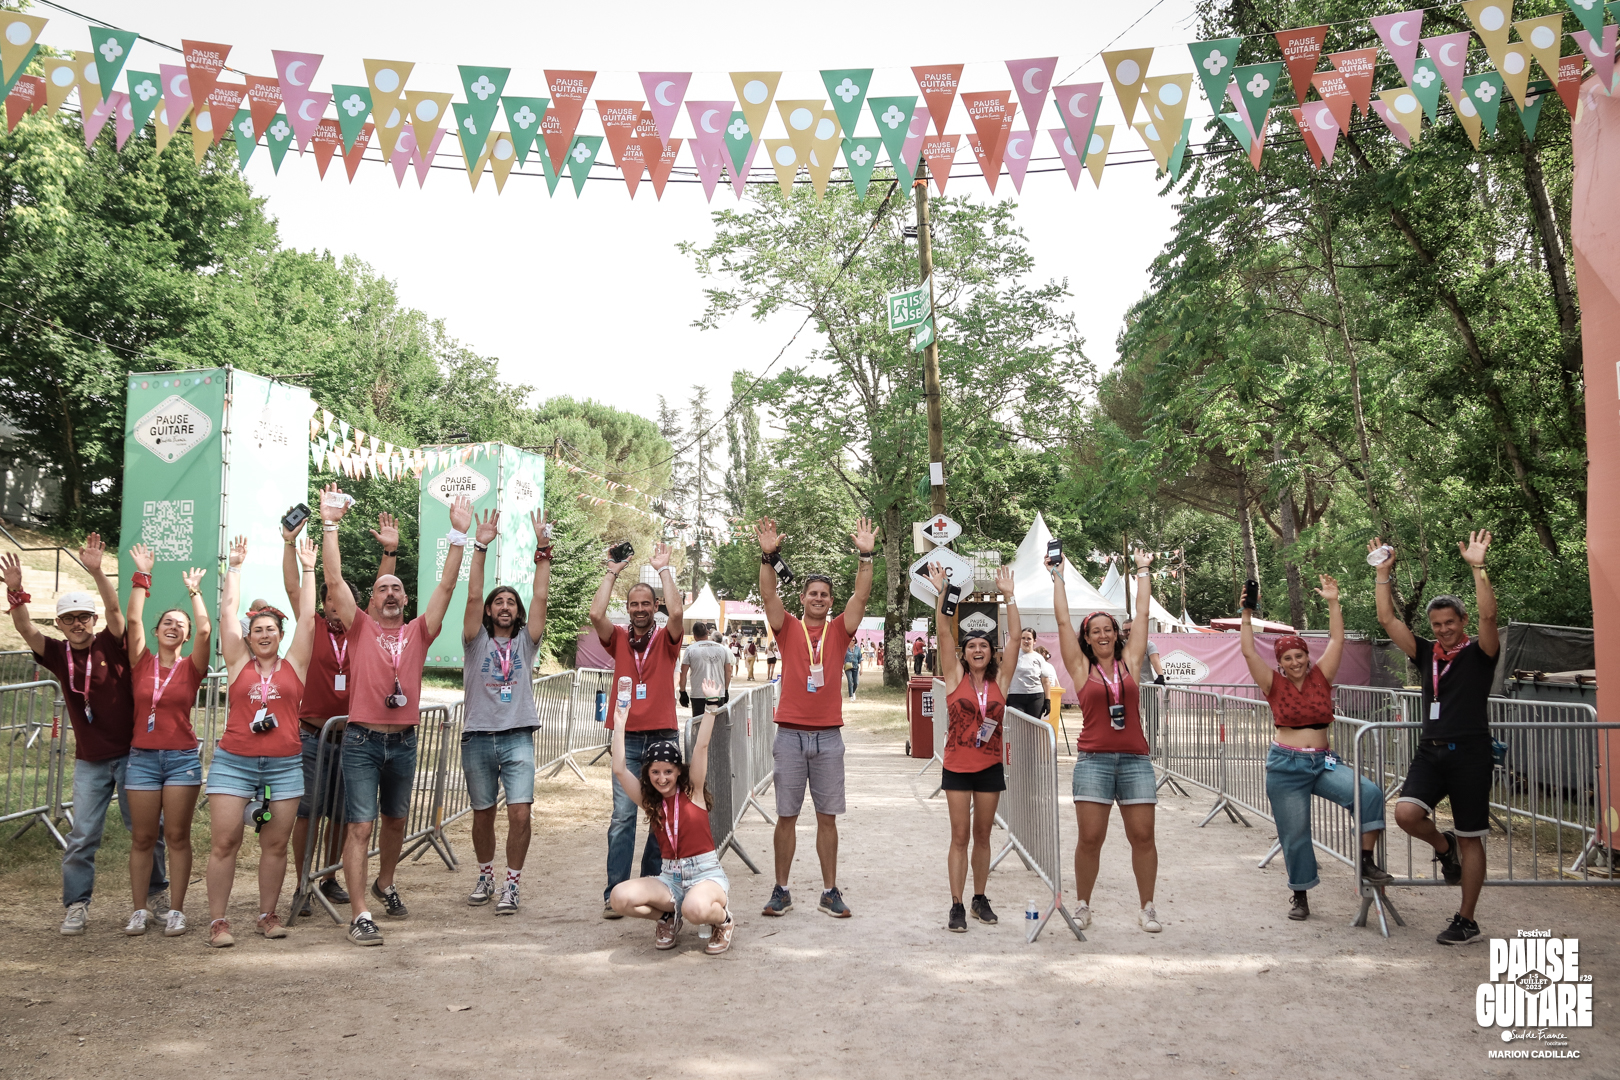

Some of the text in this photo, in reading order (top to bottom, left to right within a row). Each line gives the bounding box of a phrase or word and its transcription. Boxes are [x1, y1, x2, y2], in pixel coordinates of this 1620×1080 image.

[1289, 36, 1315, 47] PAUSE
[1284, 44, 1320, 55] GUITARE
[192, 49, 220, 60] PAUSE
[186, 55, 224, 66] GUITARE
[1342, 58, 1368, 66] PAUSE
[1338, 64, 1374, 73] GUITARE
[15, 80, 35, 90] AUSE
[556, 78, 584, 86] PAUSE
[1322, 78, 1344, 86] PAUS
[214, 88, 239, 96] PAUSE
[254, 84, 281, 93] PAUSE
[550, 84, 588, 94] GUITARE
[208, 94, 242, 104] GUITARE
[974, 99, 1000, 108] PAUSE
[970, 106, 1005, 114] GUITARE
[156, 414, 188, 425] PAUSE
[150, 424, 194, 436] GUITARE
[440, 484, 476, 492] GUITARE
